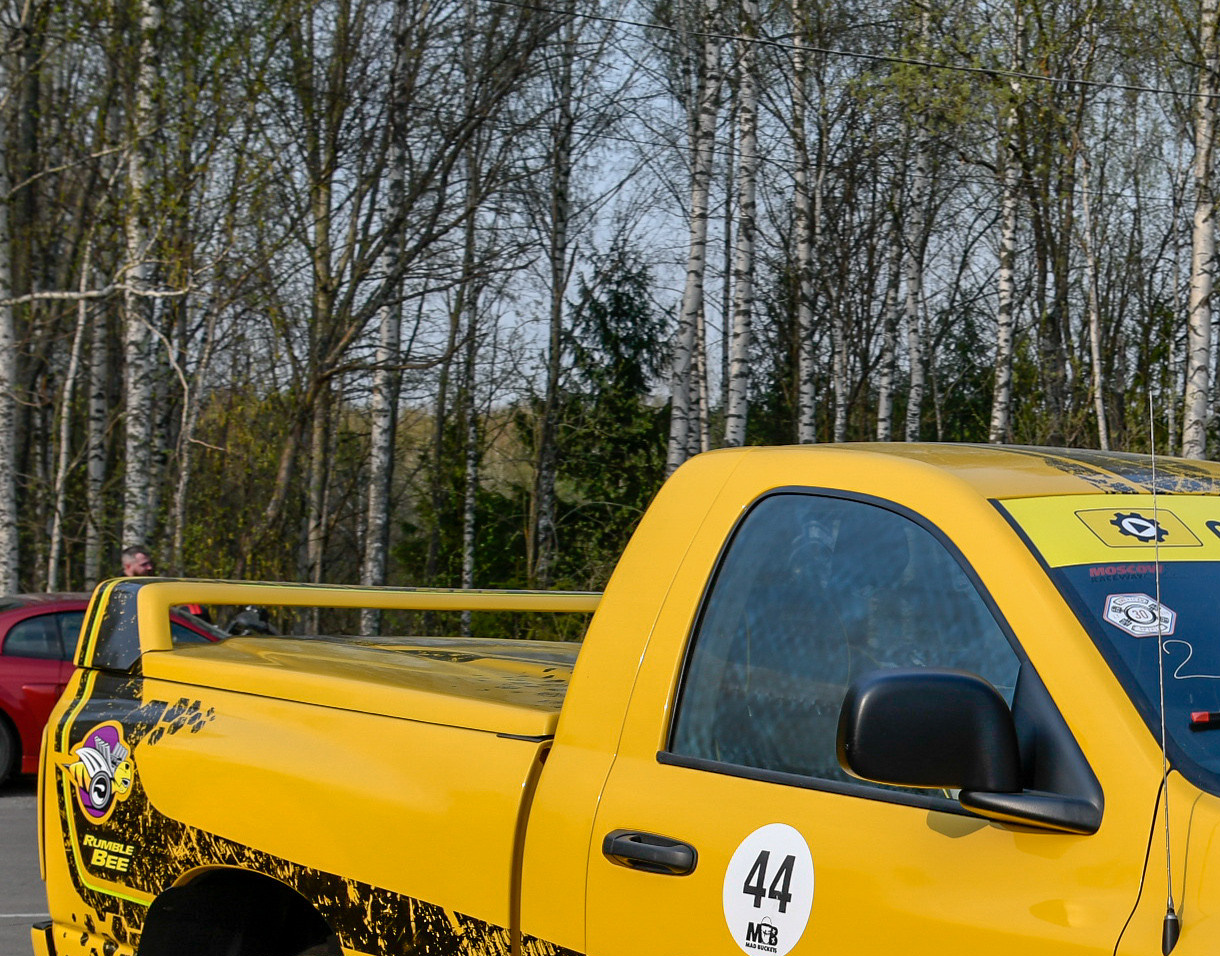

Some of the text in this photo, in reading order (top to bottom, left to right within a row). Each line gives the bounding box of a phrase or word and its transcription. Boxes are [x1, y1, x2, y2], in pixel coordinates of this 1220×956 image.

[1132, 608, 1149, 620] 30
[743, 850, 796, 914] 44
[757, 944, 777, 953] BUCKETS
